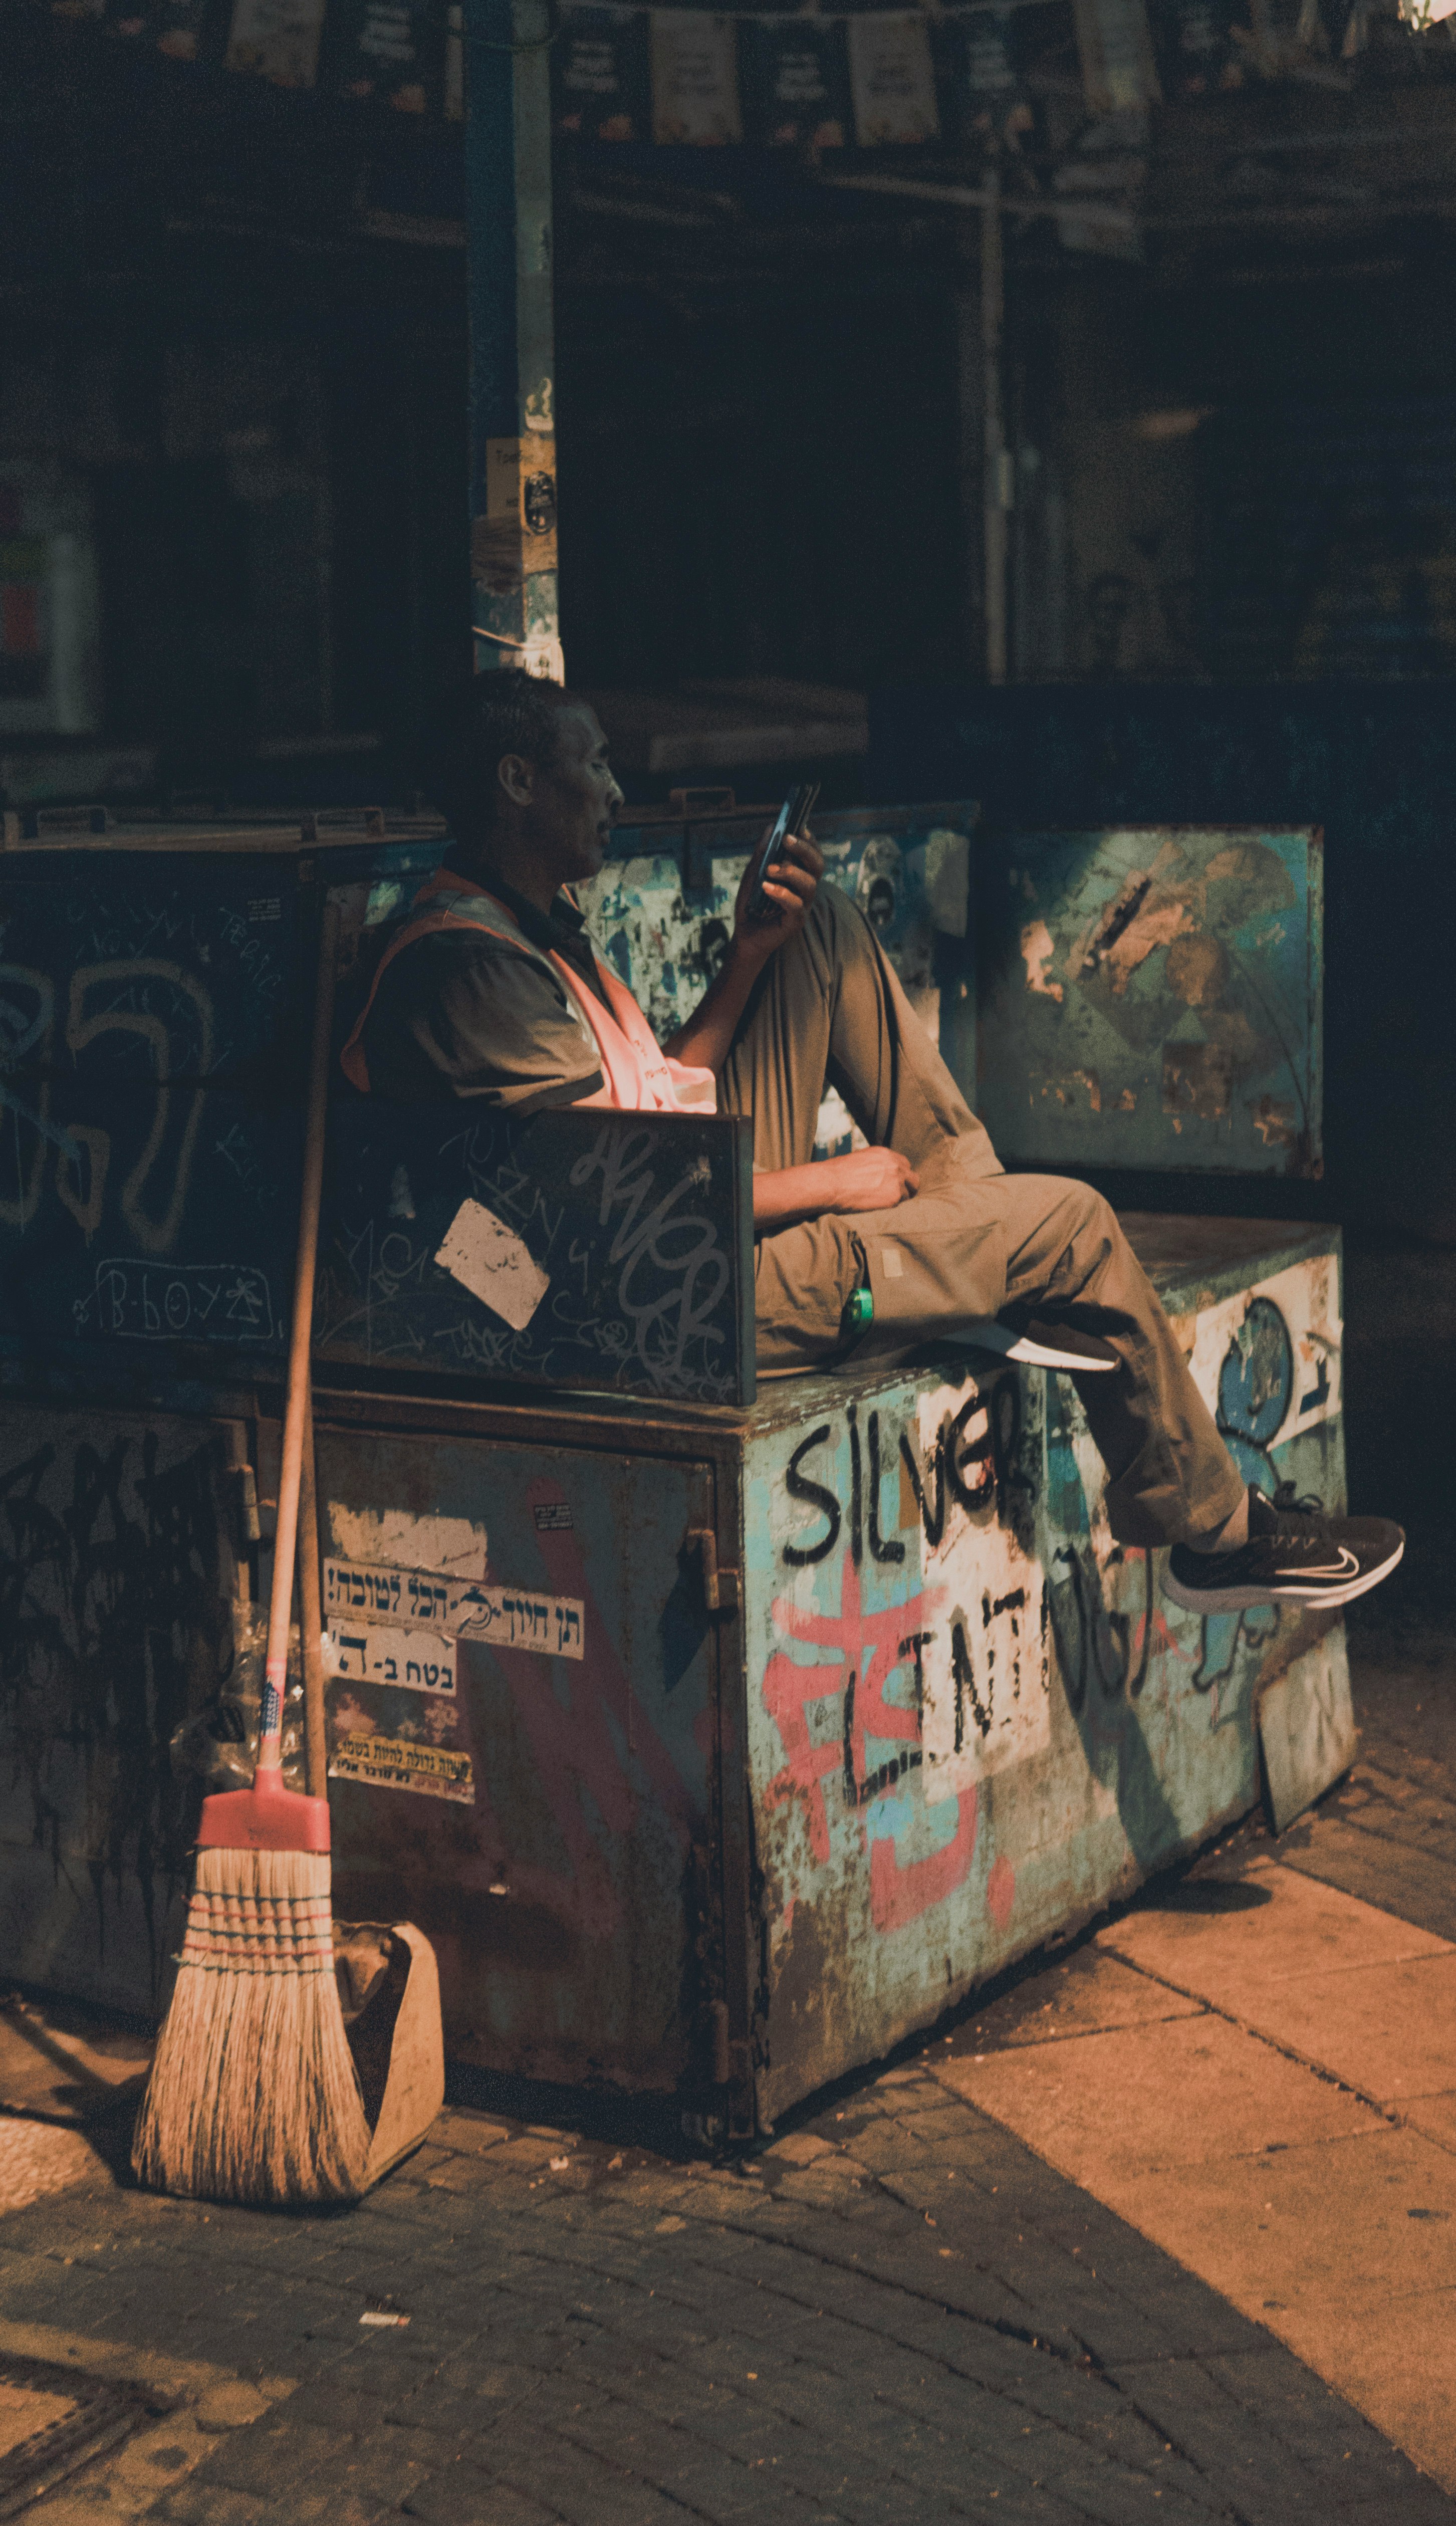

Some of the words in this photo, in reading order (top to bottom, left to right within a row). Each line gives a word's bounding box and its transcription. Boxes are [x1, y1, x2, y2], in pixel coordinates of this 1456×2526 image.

[328, 1567, 401, 1613] לטובה!
[408, 1577, 447, 1620] הכל
[502, 1597, 548, 1643] חיוך
[556, 1606, 580, 1652] תן
[405, 1660, 453, 1690] בטח
